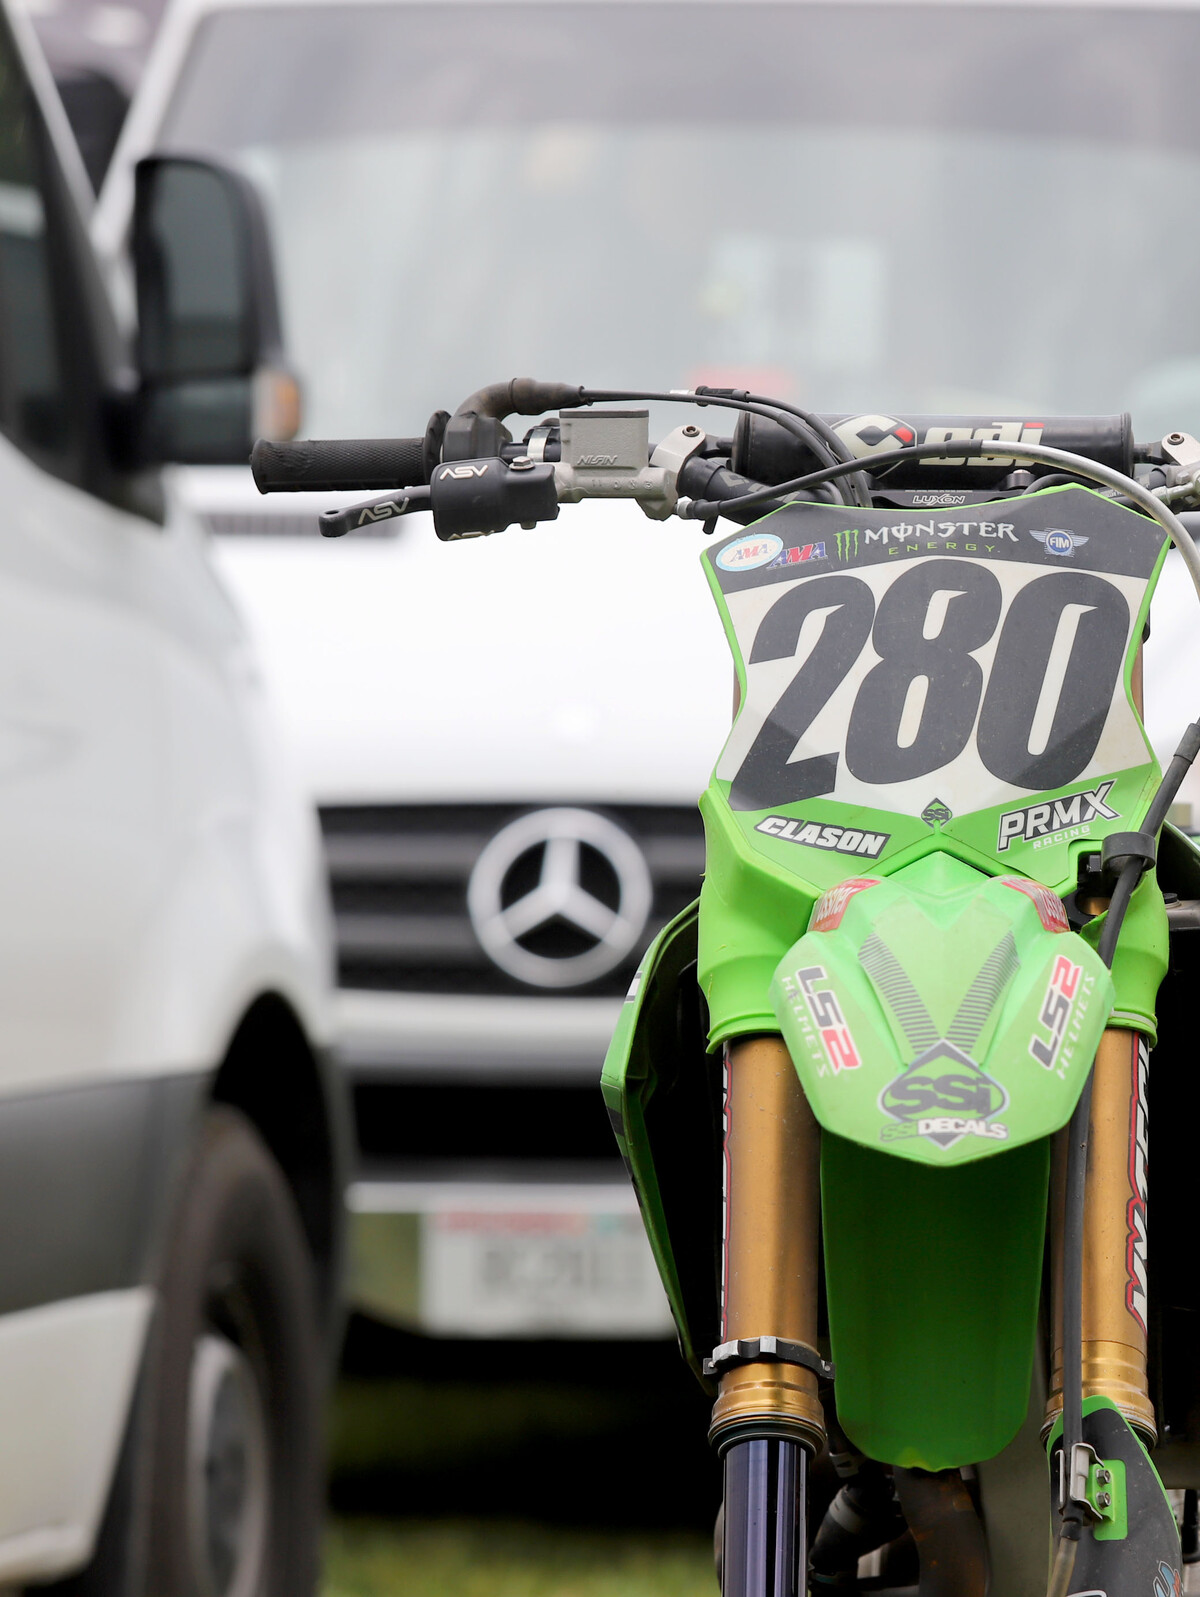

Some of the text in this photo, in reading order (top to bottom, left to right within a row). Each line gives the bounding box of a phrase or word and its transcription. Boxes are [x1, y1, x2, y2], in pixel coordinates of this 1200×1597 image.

[440, 465, 488, 480] ASV
[358, 497, 409, 525] ASV
[912, 493, 966, 506] LUXON
[730, 543, 768, 563] AMA
[766, 541, 827, 569] AMA
[888, 541, 996, 555] ENERGY
[1050, 537, 1070, 549] FIM
[728, 558, 1131, 812] 280
[998, 779, 1120, 852] PRMX
[755, 816, 889, 857] CLASON
[1033, 825, 1091, 849] RACING
[795, 965, 862, 1076] LS2
[1028, 954, 1083, 1070] LS2
